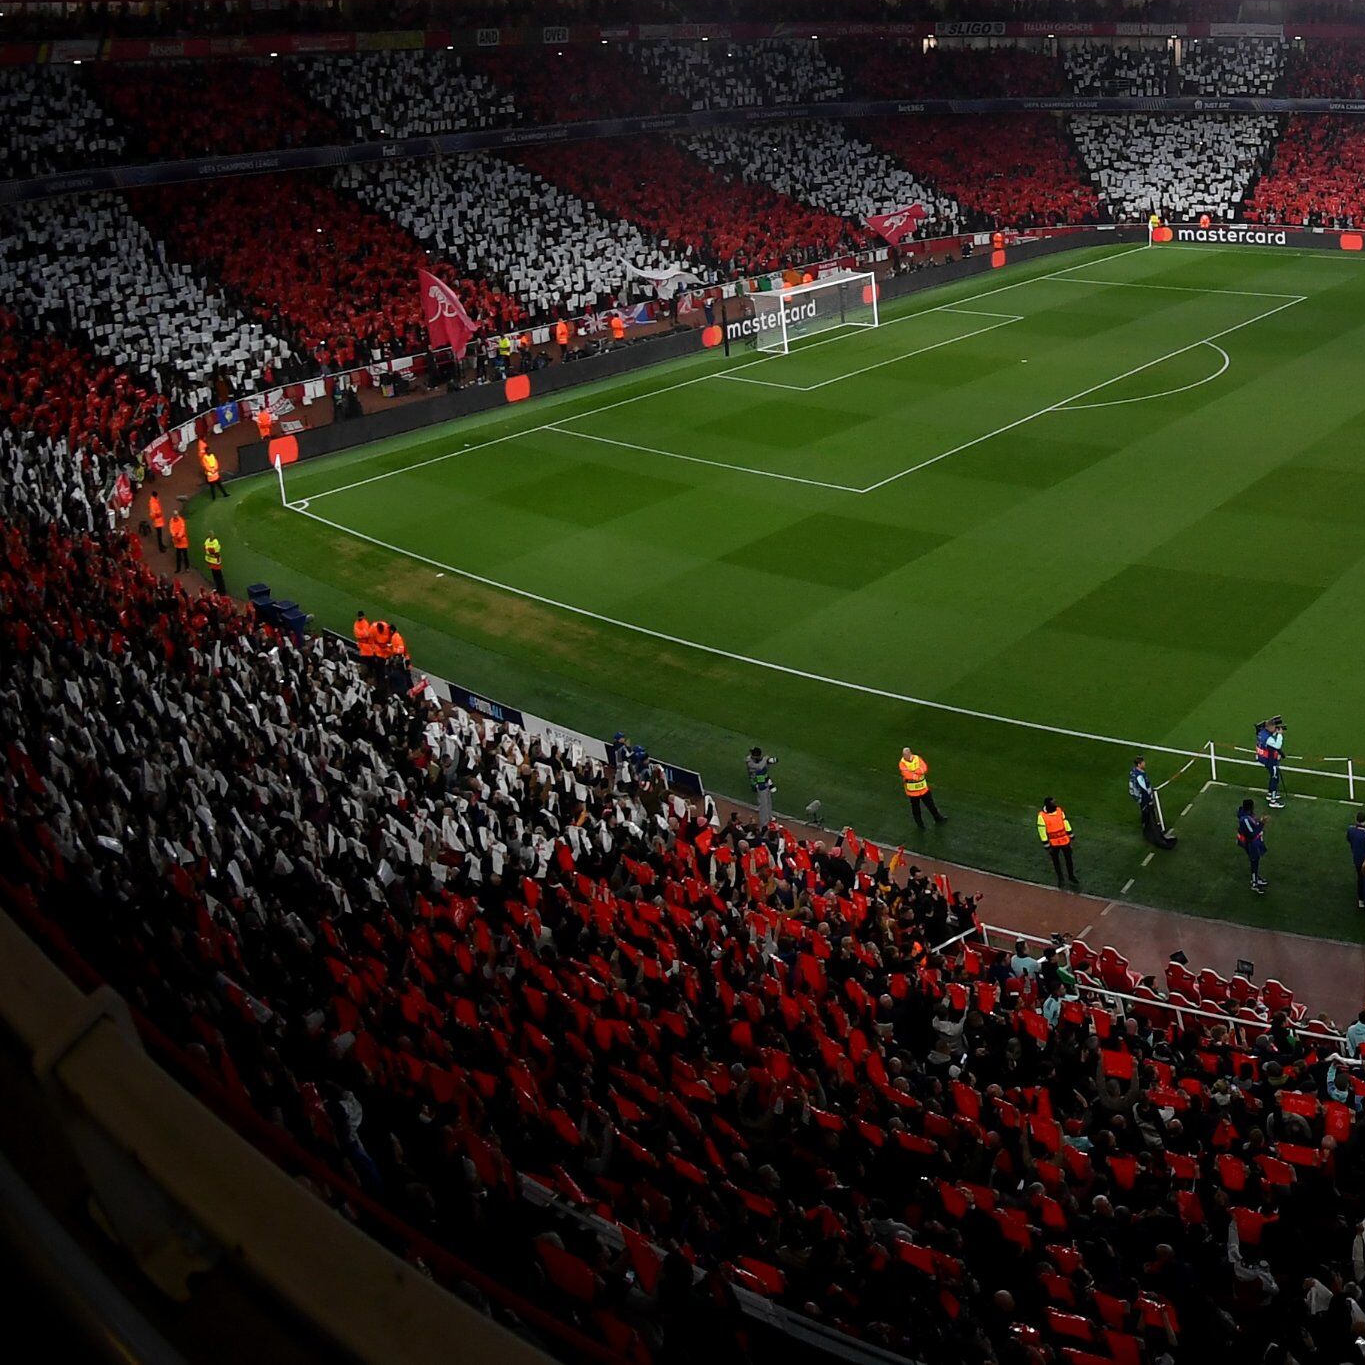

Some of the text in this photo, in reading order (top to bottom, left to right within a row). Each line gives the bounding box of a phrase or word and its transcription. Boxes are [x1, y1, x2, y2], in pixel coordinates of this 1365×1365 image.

[544, 27, 567, 42] OVER
[948, 23, 992, 35] SLIGO
[479, 29, 498, 45] AND
[148, 40, 184, 57] Arsenal
[1329, 102, 1345, 110] UEFA
[1178, 226, 1287, 245] mastercard
